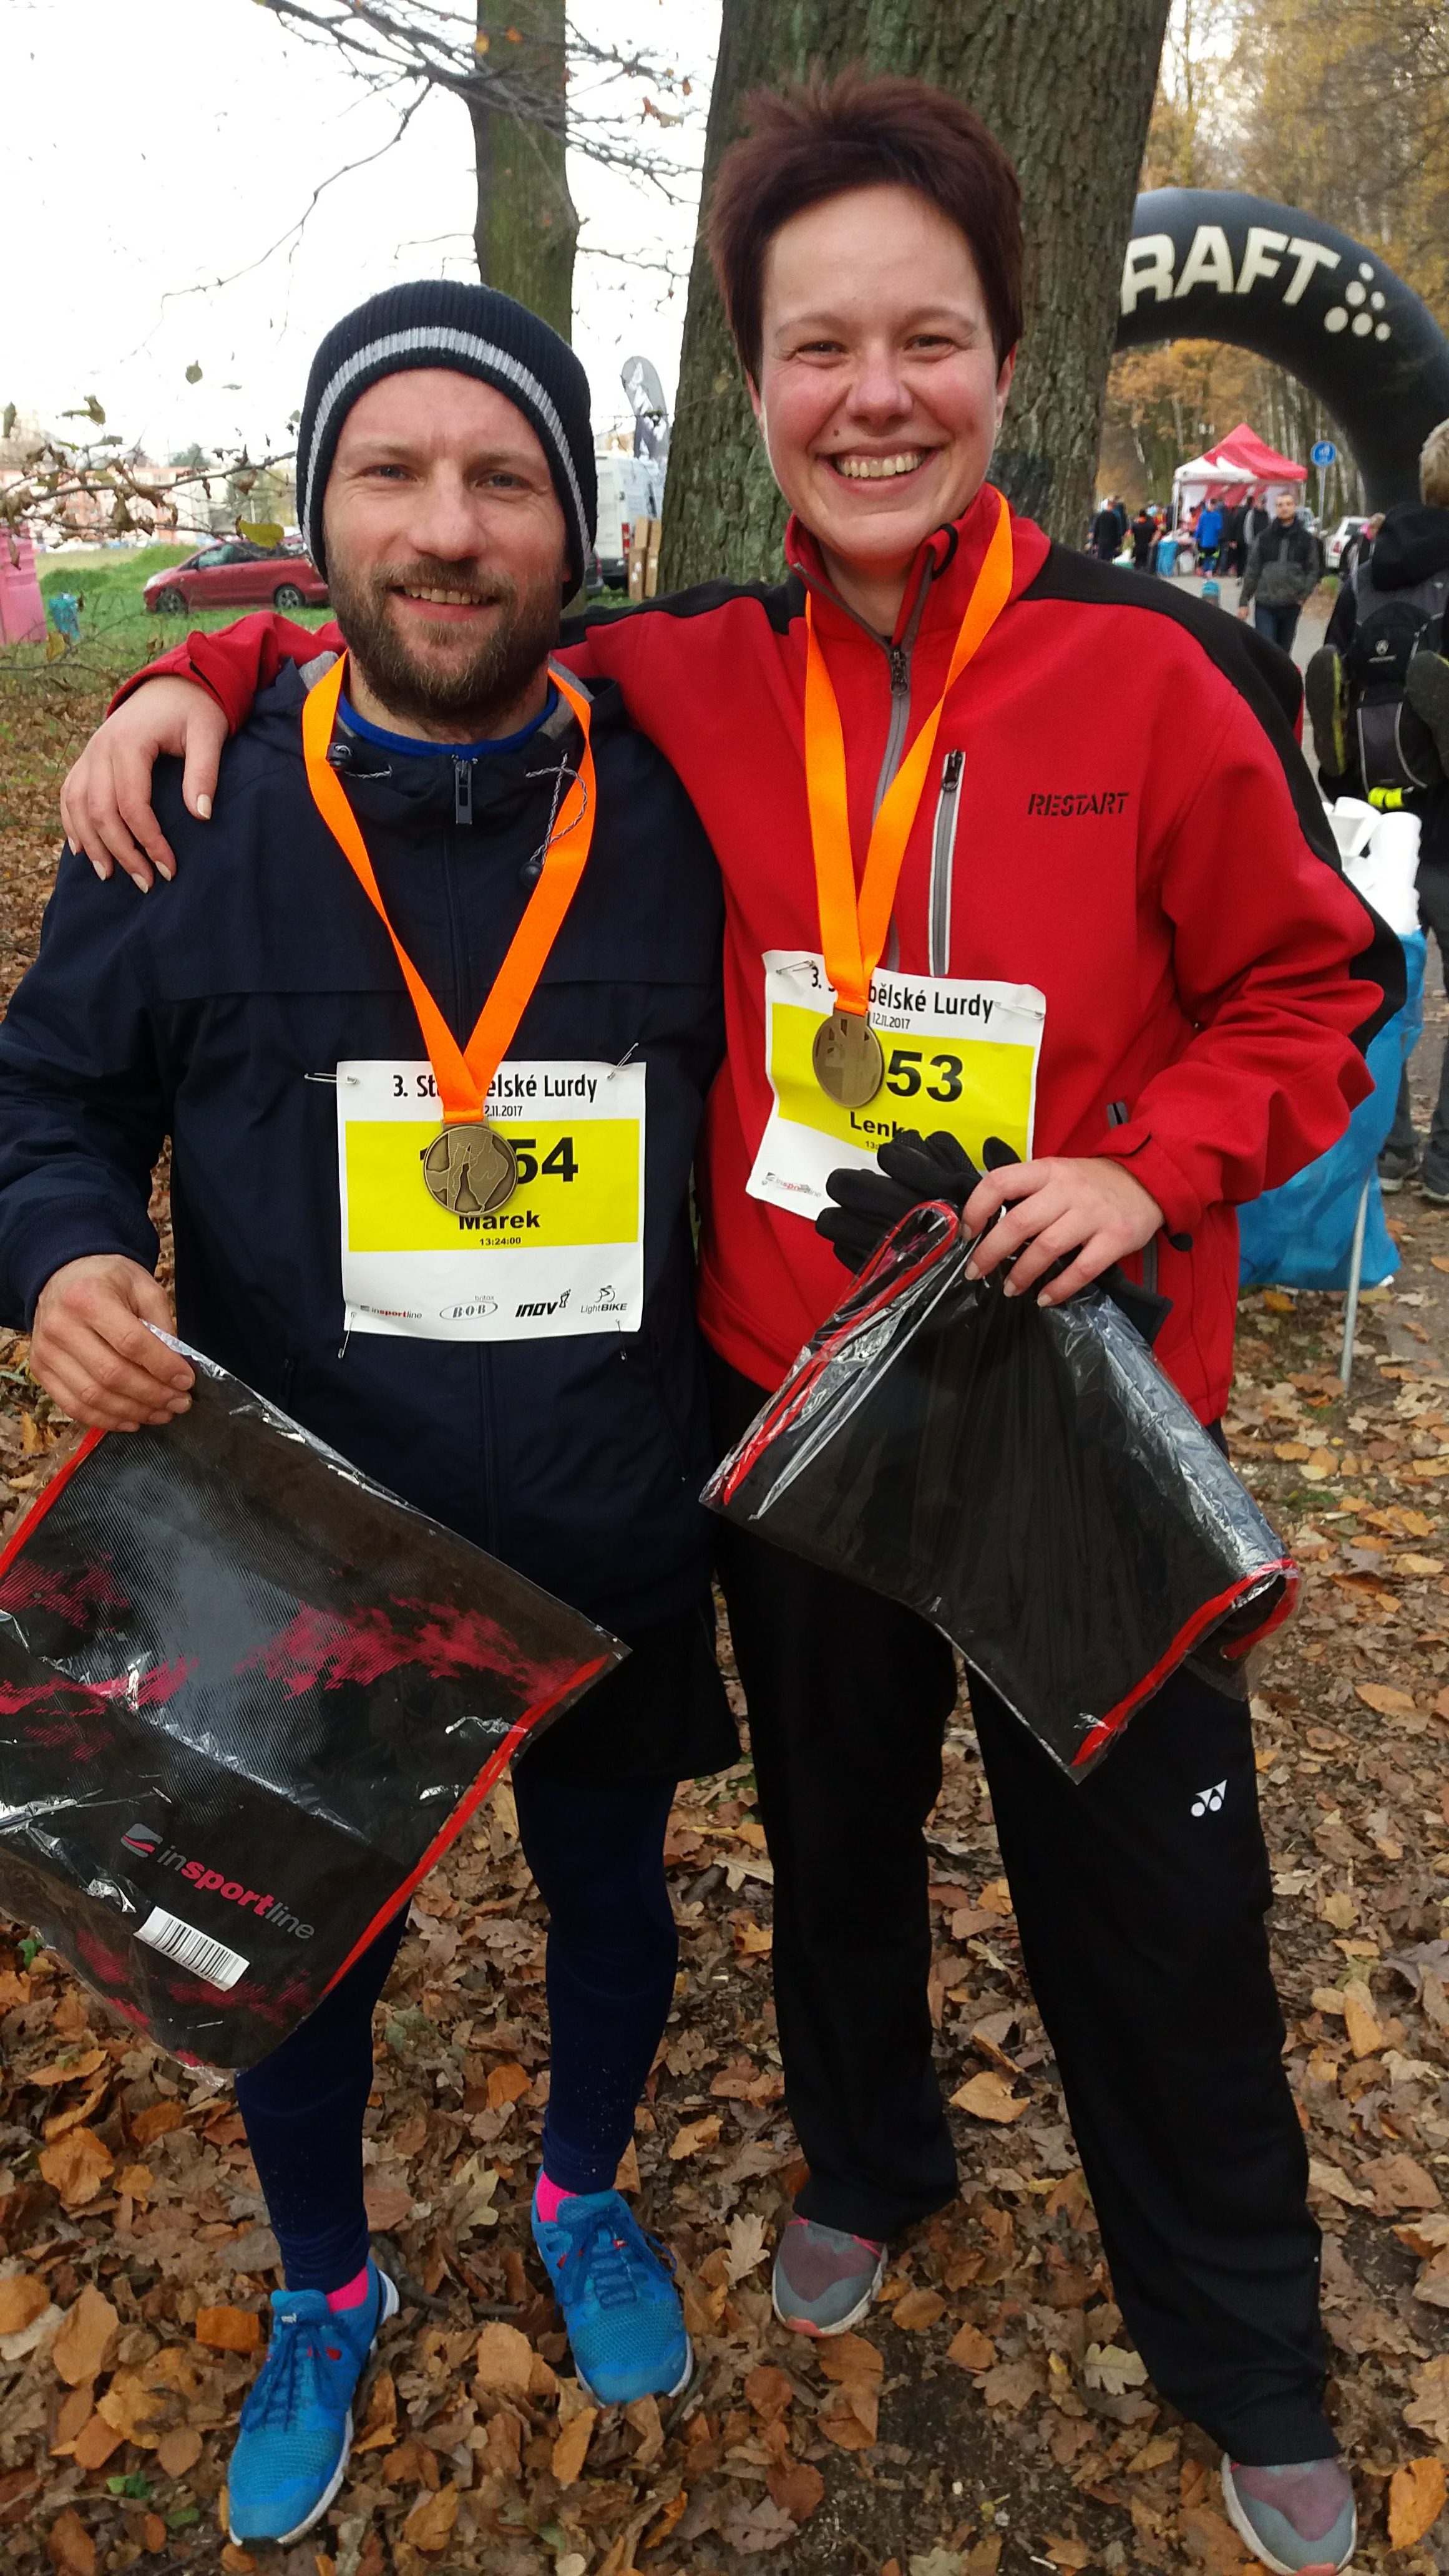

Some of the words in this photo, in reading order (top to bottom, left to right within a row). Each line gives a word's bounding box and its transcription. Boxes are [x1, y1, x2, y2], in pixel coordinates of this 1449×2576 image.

[1120, 225, 1341, 316] RAFT
[1028, 793, 1129, 816] RESTART
[811, 965, 822, 989] 3.
[934, 992, 994, 1024] Lurdy
[393, 1075, 409, 1098] 3.
[544, 1074, 598, 1103] Lurdy
[886, 1050, 964, 1103] 53
[484, 1105, 523, 1118] 2.11.2017
[850, 1111, 905, 1138] Lenk
[459, 1210, 541, 1231] Marek
[479, 1237, 522, 1246] 13:24:00
[580, 1302, 628, 1315] LightBIKE
[157, 1845, 315, 1939] insportline
